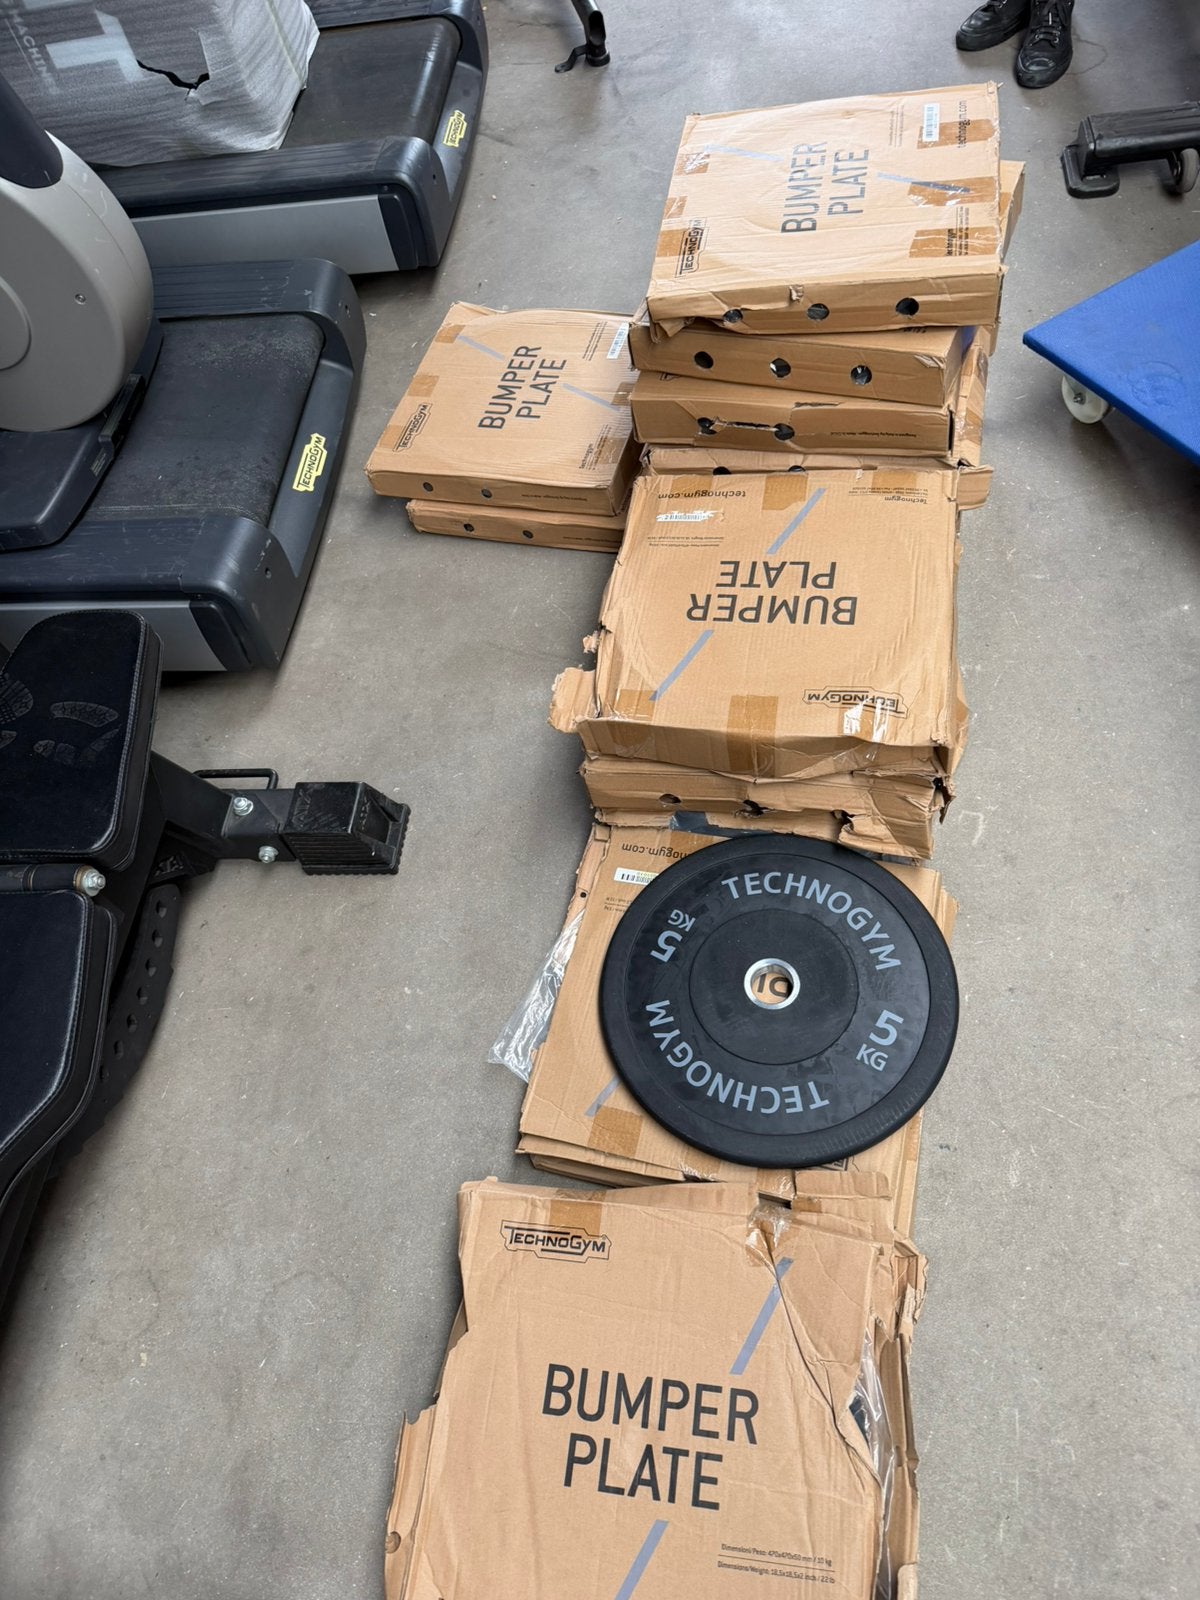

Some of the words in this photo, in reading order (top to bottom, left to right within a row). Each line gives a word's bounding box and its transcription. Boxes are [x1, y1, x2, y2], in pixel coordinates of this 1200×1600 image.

[781, 141, 828, 233] BUMPER
[827, 149, 869, 216] PLATE
[478, 345, 542, 430] BUMPER
[515, 359, 567, 419] PLATE
[657, 489, 746, 500] technogym.com
[884, 495, 928, 505] Technogym
[715, 560, 837, 589] PLATE
[686, 593, 859, 626] BUMPER
[667, 909, 696, 932] KG
[721, 871, 902, 971] TECHNOGYM
[650, 930, 683, 963] 5
[868, 1009, 904, 1047] 5
[645, 999, 830, 1115] TECHNOGYM
[856, 1047, 888, 1072] KG
[542, 1362, 760, 1446] BUMPER
[562, 1434, 724, 1512] PLATE
